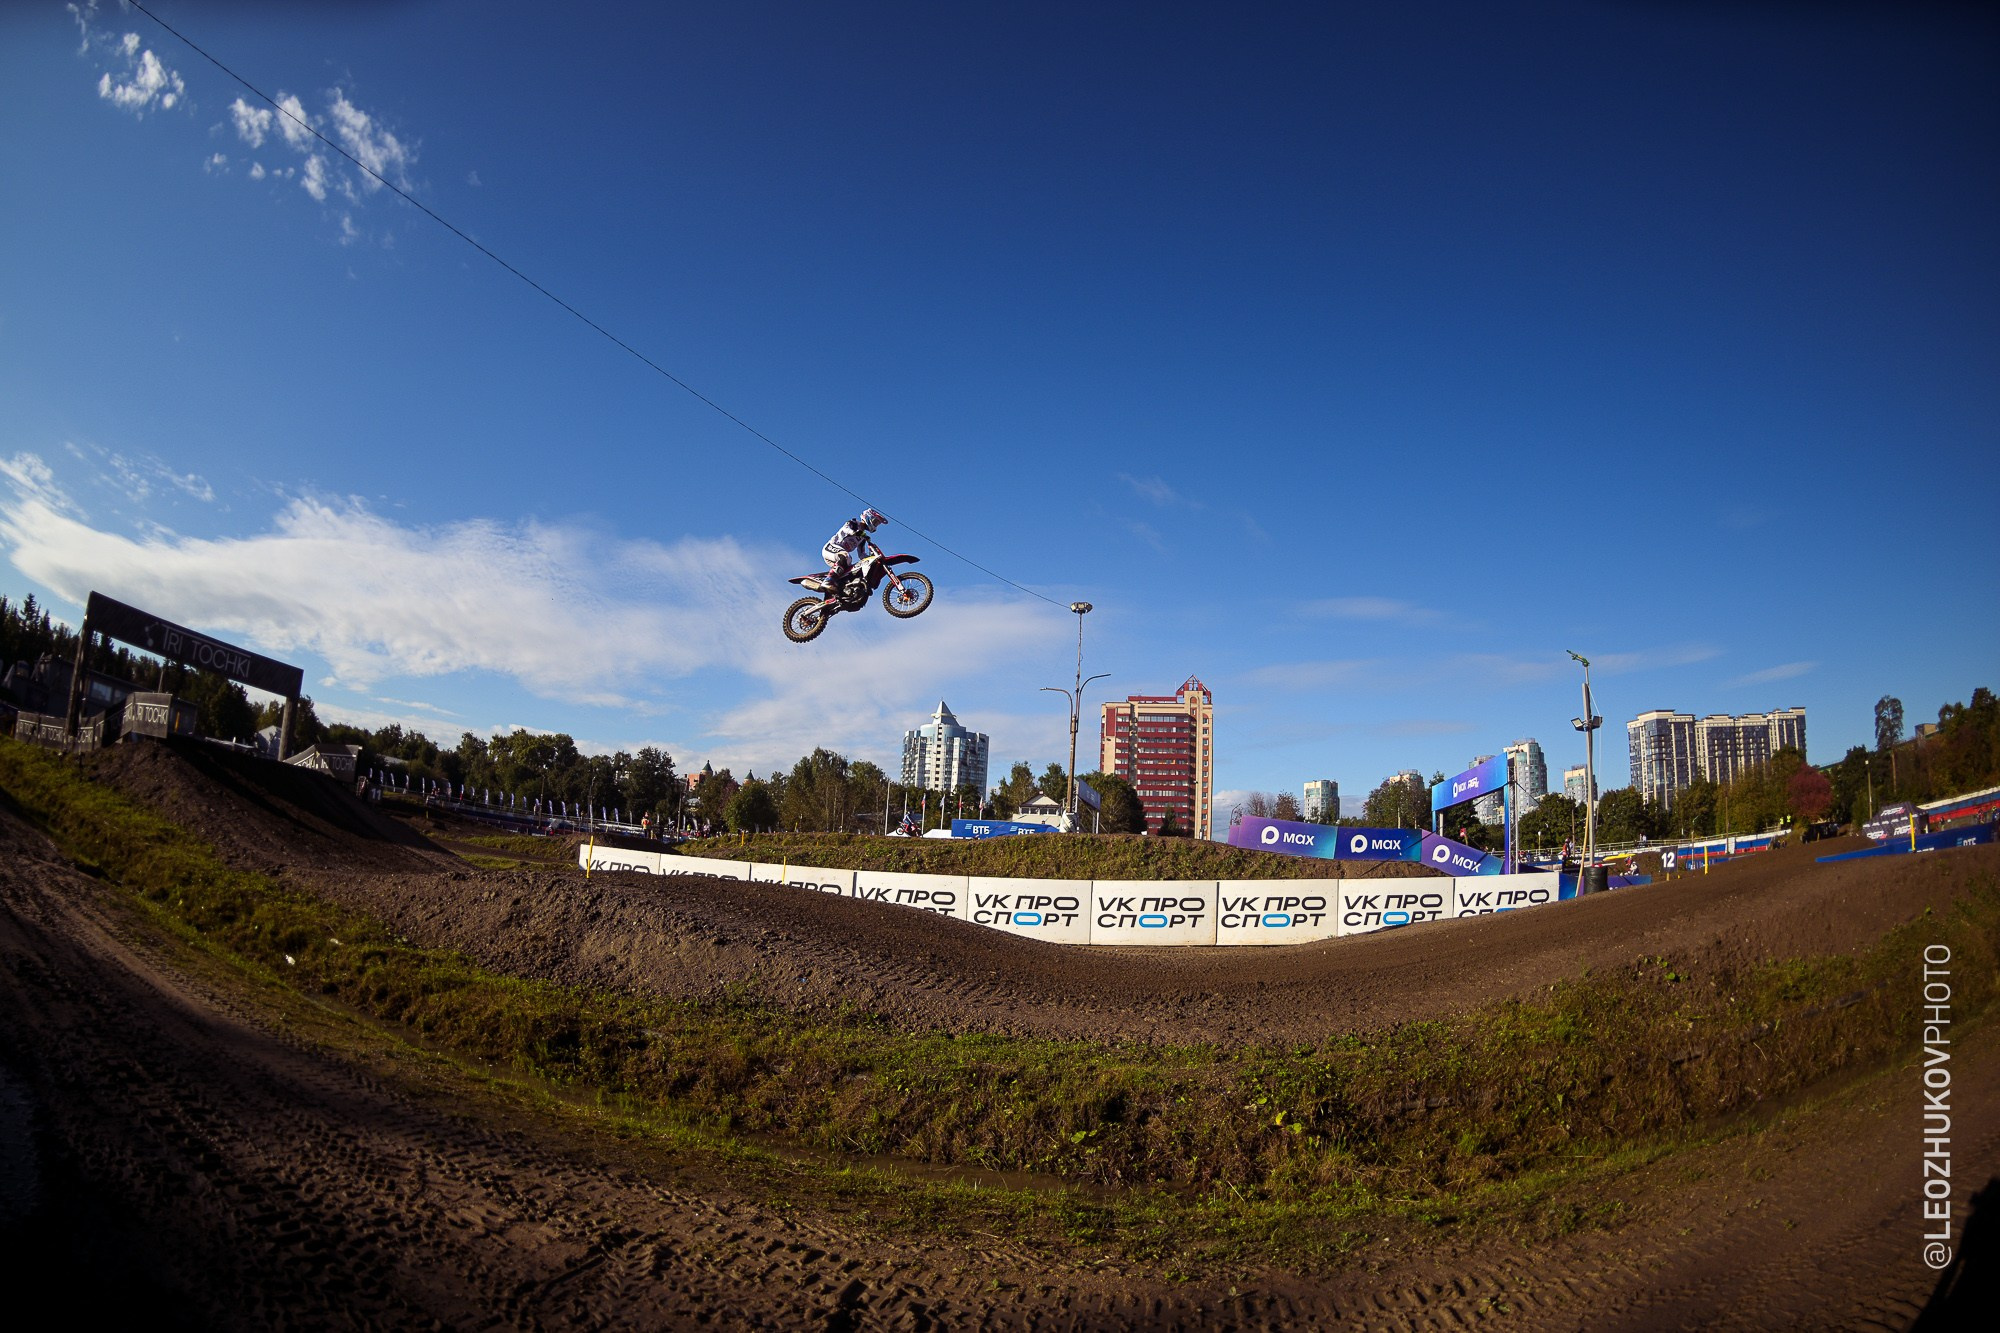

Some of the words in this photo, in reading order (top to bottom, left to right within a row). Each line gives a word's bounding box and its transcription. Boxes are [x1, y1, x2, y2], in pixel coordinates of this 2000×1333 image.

[160, 624, 184, 655] TRI
[191, 640, 251, 678] TOCHKI
[371, 788, 382, 801] 11
[972, 825, 990, 835] ВТБ
[1661, 852, 1675, 868] 12
[895, 888, 956, 905] ПРО
[975, 893, 1011, 909] VK
[1015, 895, 1080, 911] ПРО
[1098, 896, 1136, 912] VK
[1140, 897, 1205, 912] ПРО
[1221, 896, 1260, 912] VK
[1263, 896, 1327, 911] ПРО
[1343, 894, 1381, 910] VK
[1384, 893, 1443, 909] ПРО
[1459, 892, 1493, 907] VK
[1496, 889, 1550, 904] ПРО
[973, 910, 1079, 927] СПОРТ
[1097, 913, 1204, 929] СПОРТ
[1220, 913, 1326, 928] СПОРТ
[1343, 910, 1442, 927] СПОРТ
